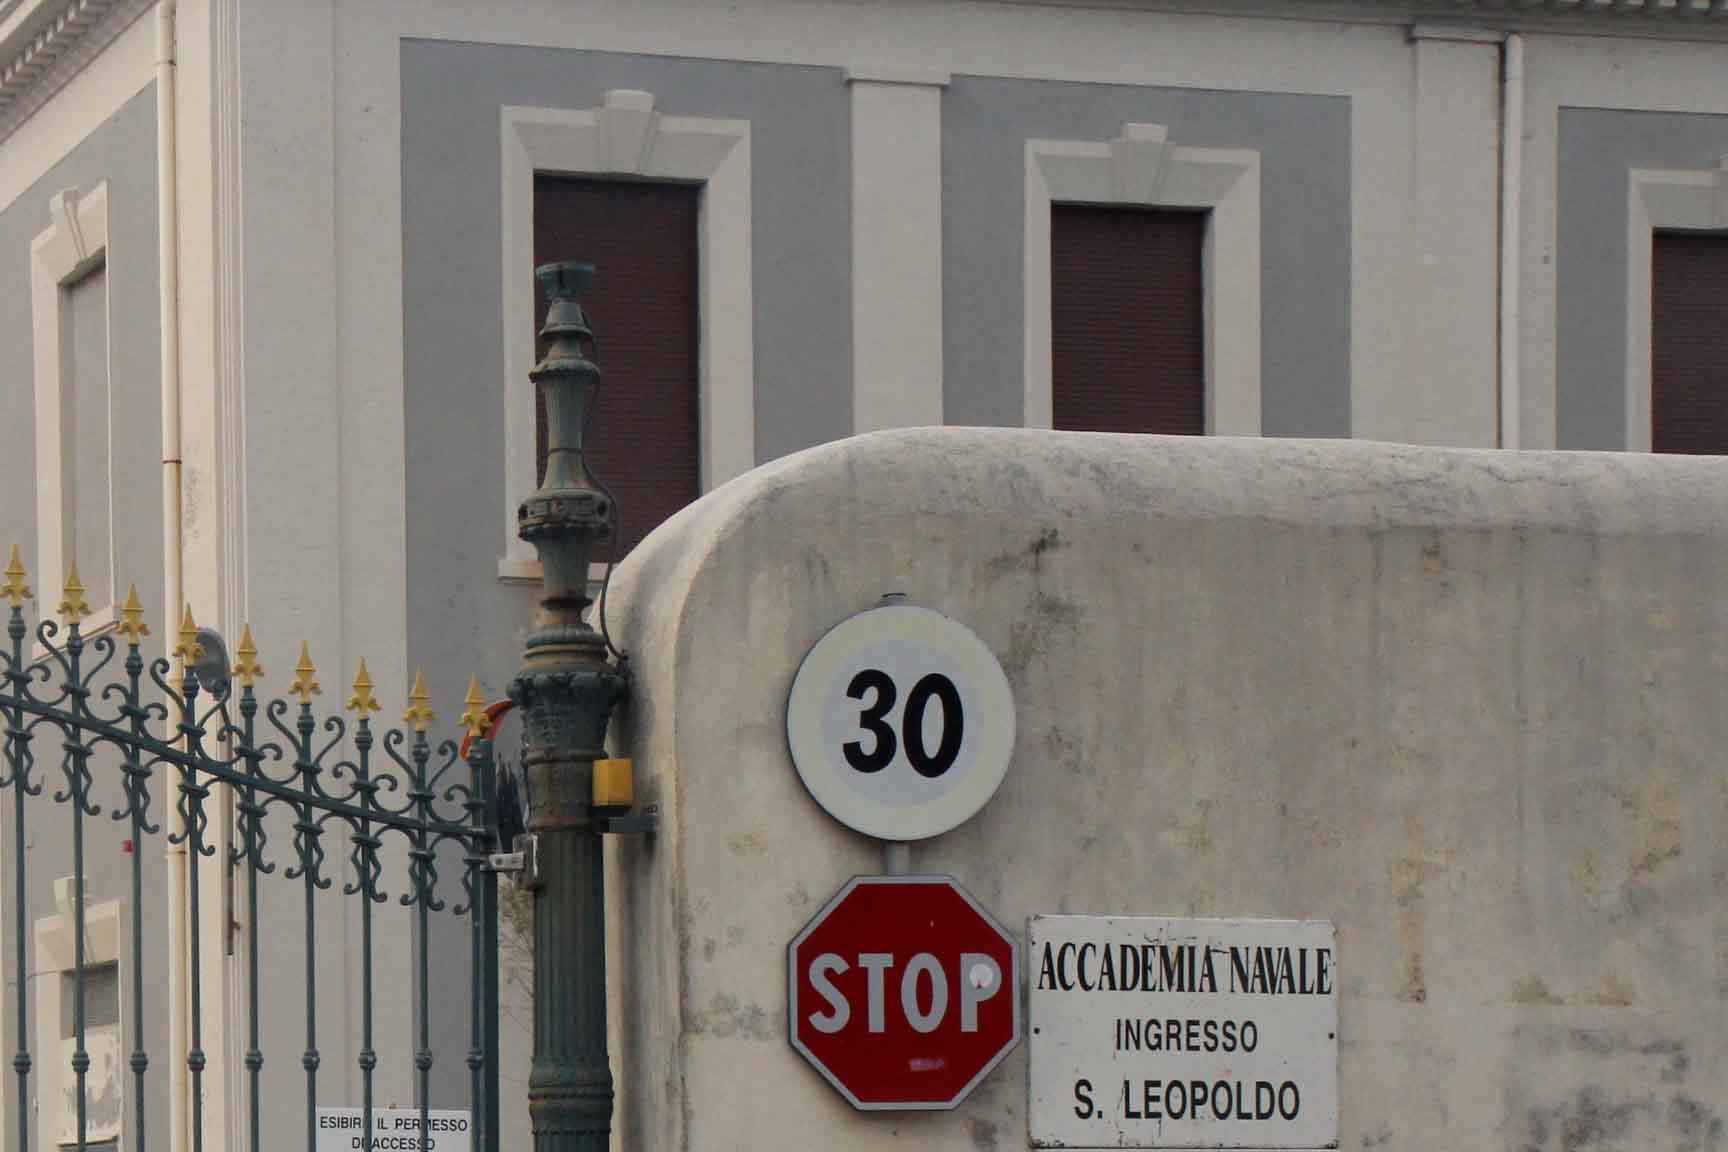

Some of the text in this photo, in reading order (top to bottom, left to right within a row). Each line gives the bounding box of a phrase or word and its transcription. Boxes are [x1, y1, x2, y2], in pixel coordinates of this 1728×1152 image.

[842, 669, 964, 778] 30
[1038, 941, 1333, 995] ACCADEMIA NAVALE
[808, 952, 1003, 1034] STOP
[1115, 1018, 1258, 1052] INGRESSO
[320, 1116, 367, 1129] ESIBIR
[377, 1118, 388, 1130] IL
[1074, 1079, 1300, 1121] S. LEOPOLDO
